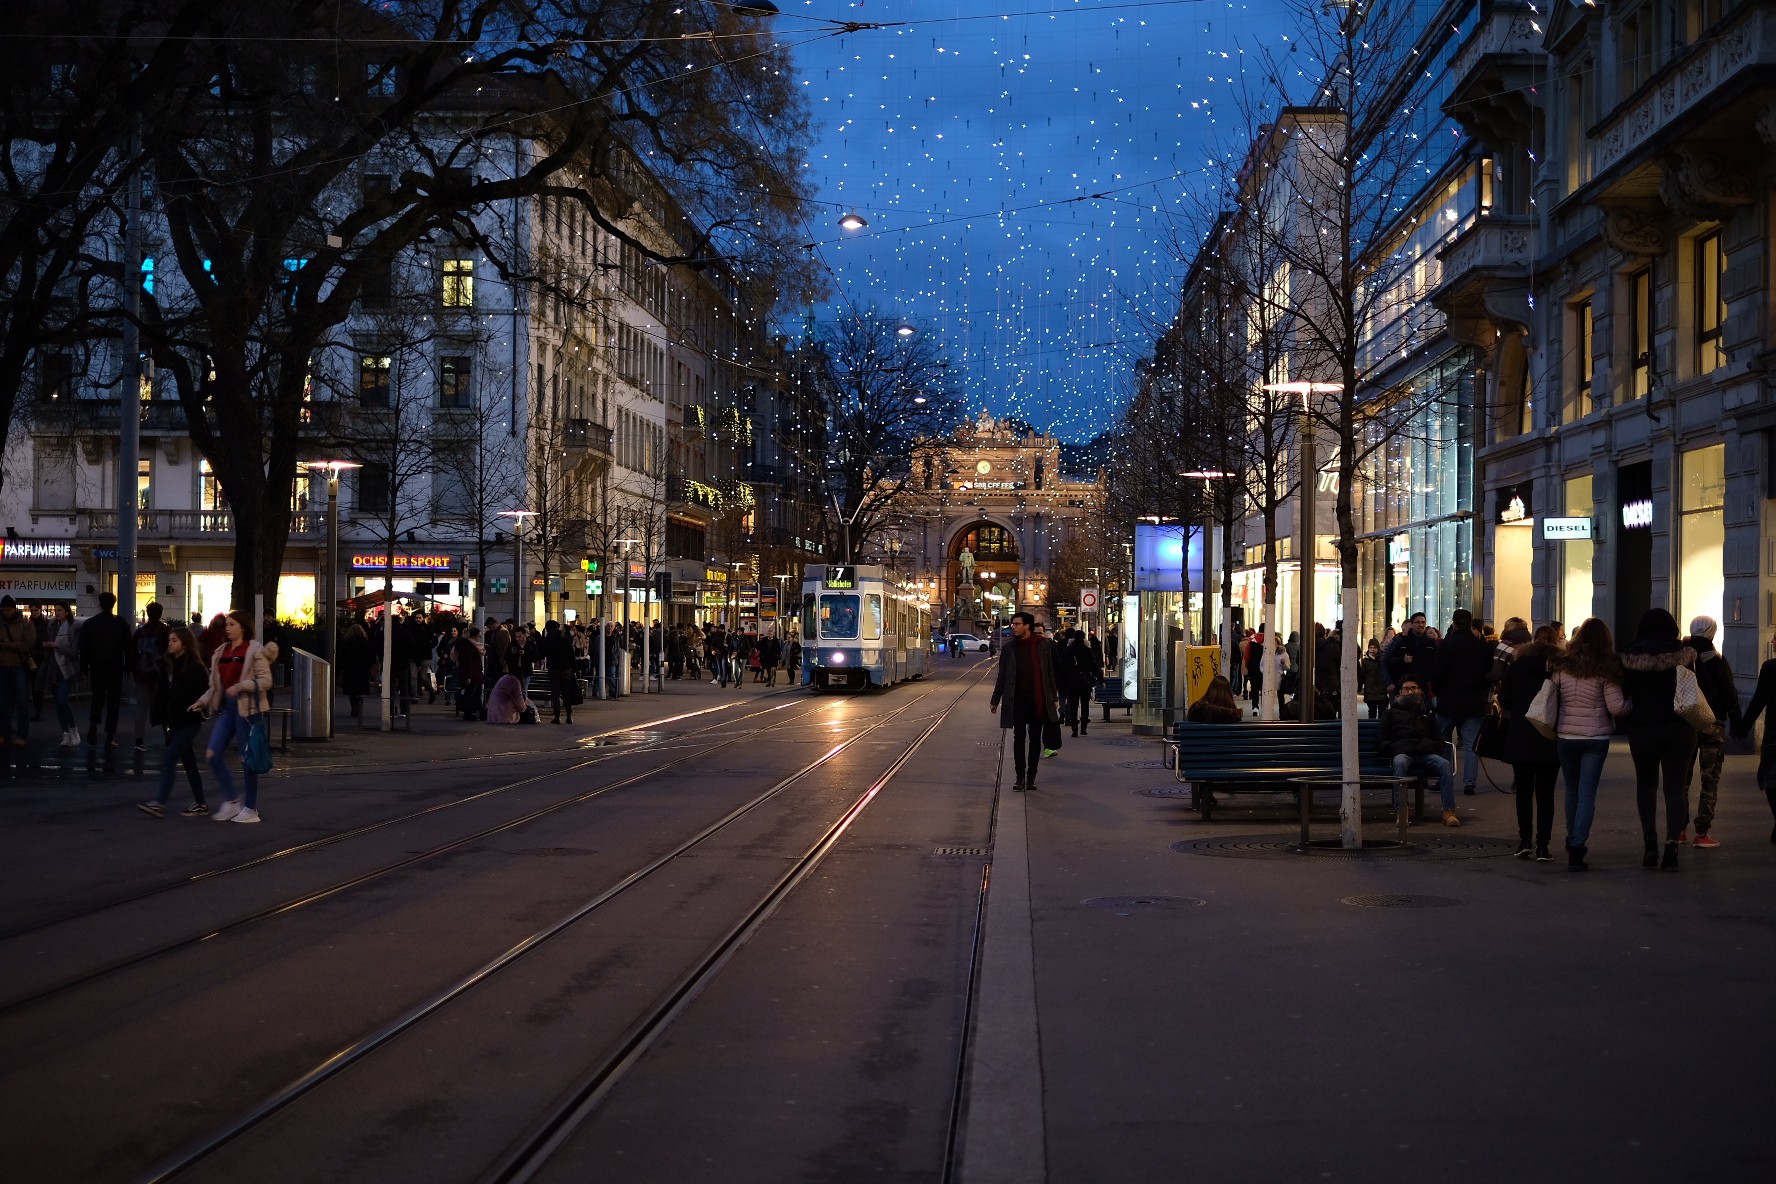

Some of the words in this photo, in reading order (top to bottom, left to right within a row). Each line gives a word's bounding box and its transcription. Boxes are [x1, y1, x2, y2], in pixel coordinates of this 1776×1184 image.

[4, 545, 71, 556] PARFUMERIE
[99, 550, 115, 558] WC
[411, 557, 450, 568] SPORT
[835, 567, 845, 579] 7
